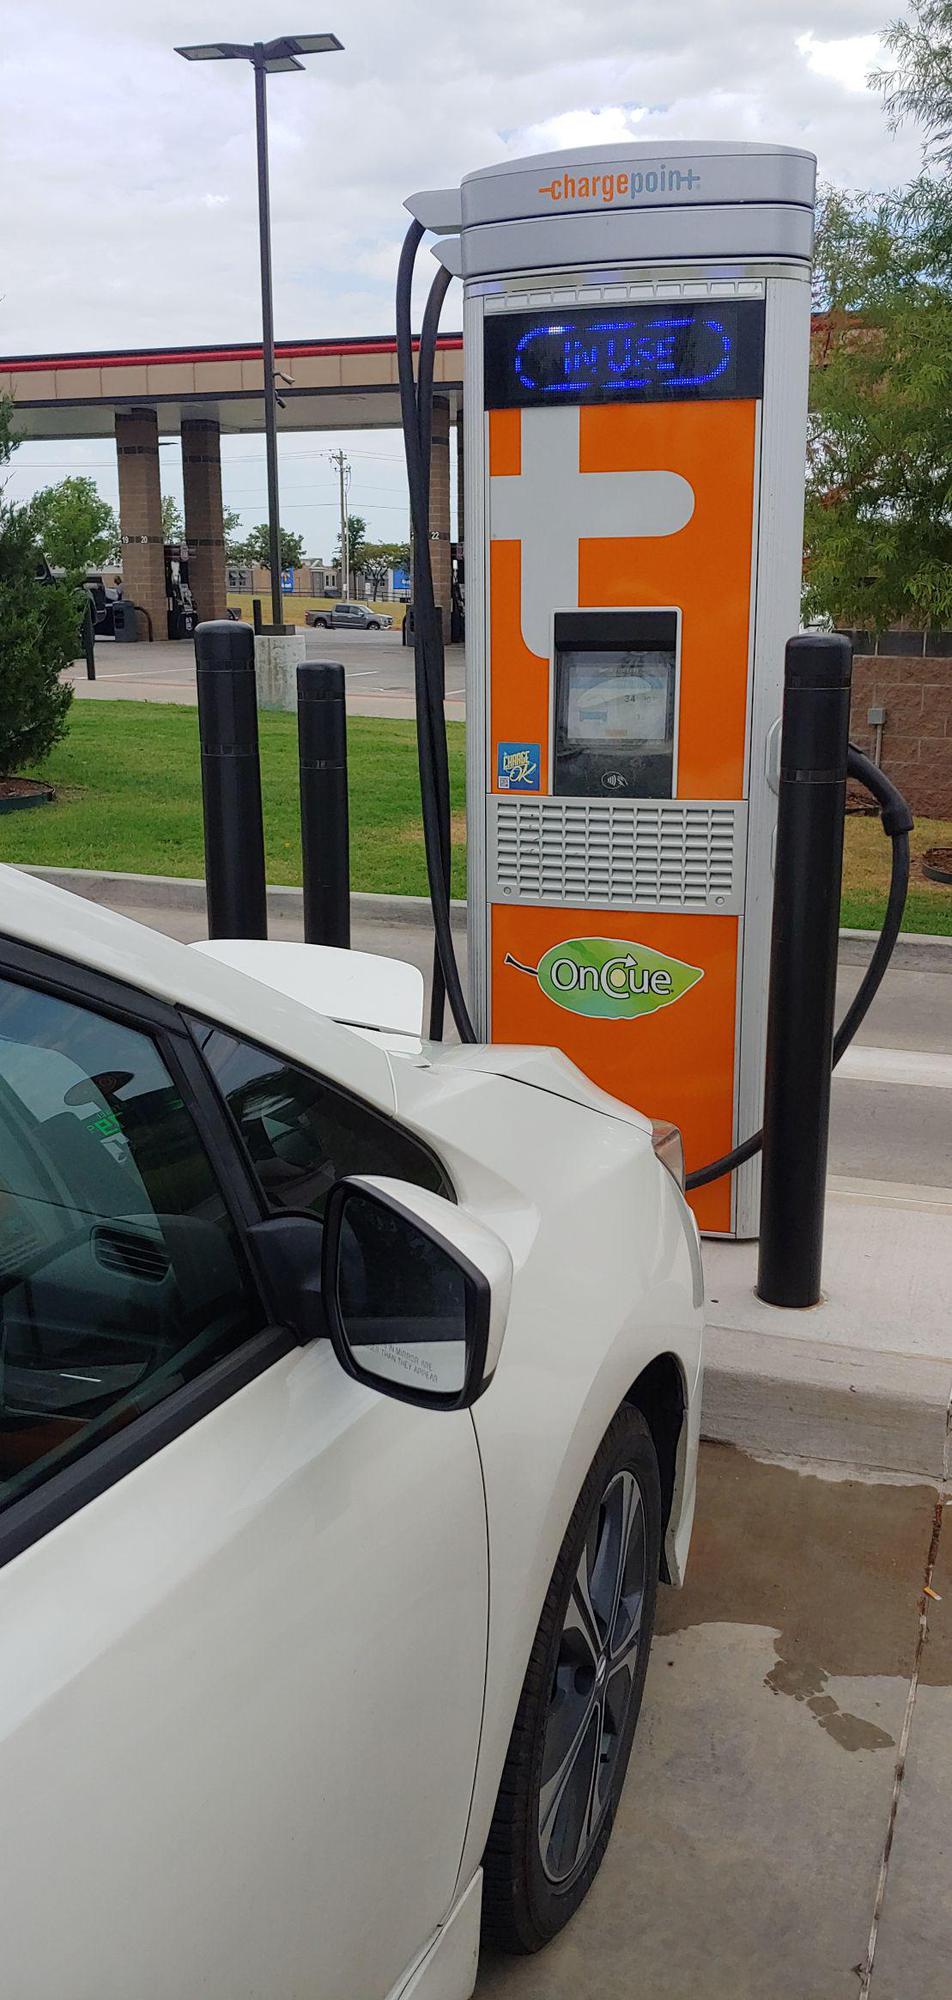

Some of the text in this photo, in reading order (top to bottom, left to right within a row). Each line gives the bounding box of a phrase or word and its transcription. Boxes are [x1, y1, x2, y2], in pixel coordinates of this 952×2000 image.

[564, 335, 676, 375] IN USE
[122, 535, 148, 544] 19 20
[431, 531, 440, 540] 22
[510, 763, 537, 784] OK
[550, 953, 673, 999] OnCue
